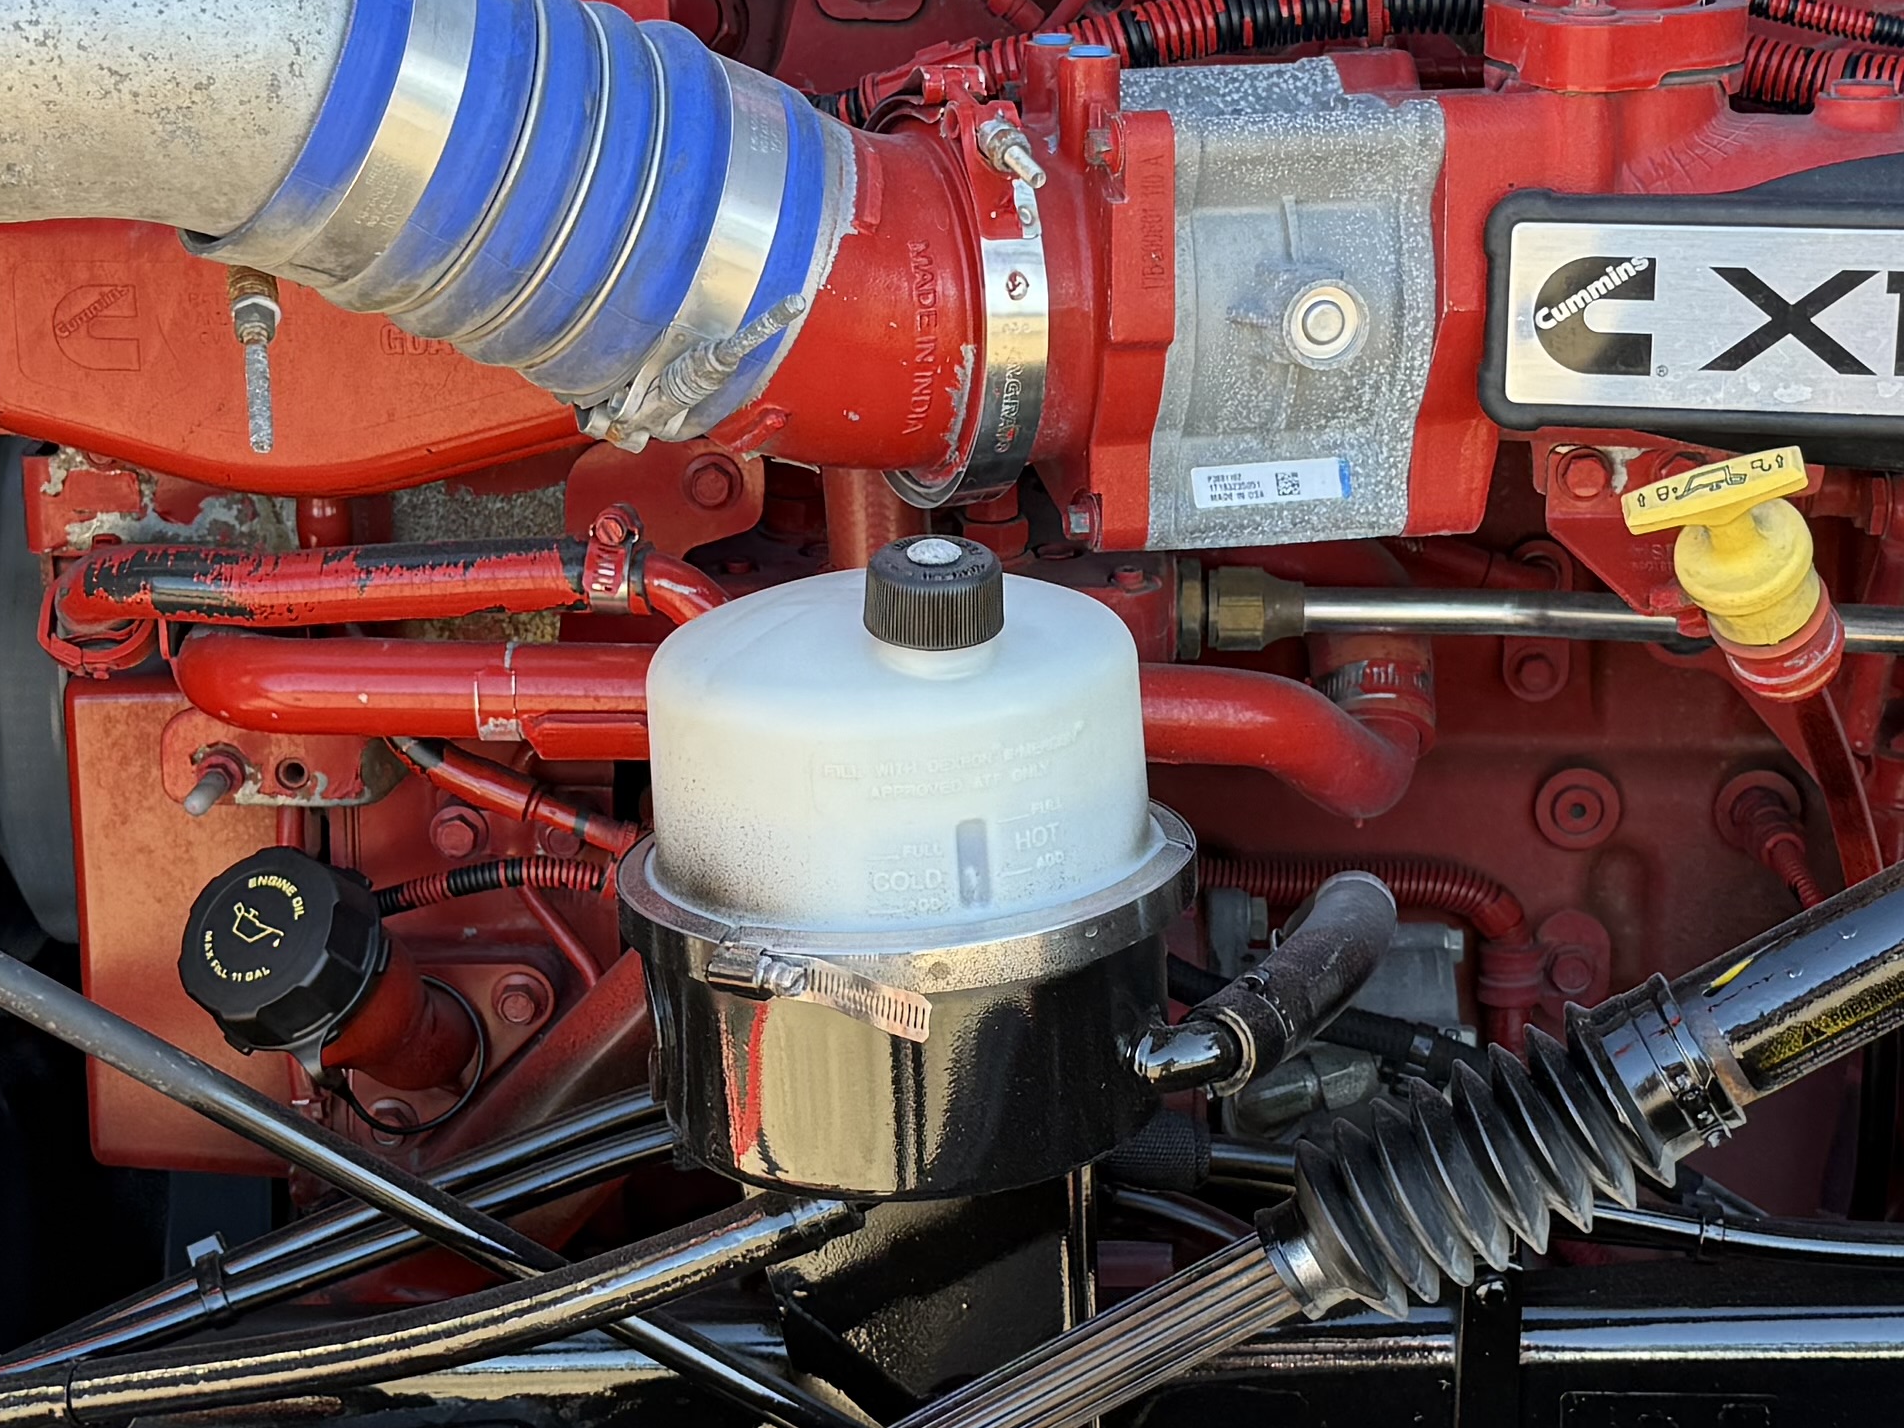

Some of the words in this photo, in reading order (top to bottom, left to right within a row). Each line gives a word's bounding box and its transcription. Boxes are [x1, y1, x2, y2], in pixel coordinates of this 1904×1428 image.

[907, 239, 939, 332] MADE
[1534, 255, 1651, 332] Cummins
[53, 283, 130, 340] Cummins
[914, 336, 936, 364] IN
[901, 368, 941, 436] INDIA
[823, 762, 864, 780] FILL
[902, 843, 944, 859] FULL
[1014, 821, 1060, 852] HOT
[248, 875, 298, 897] ENGINE
[292, 896, 305, 921] OIL
[871, 868, 944, 893] COLD
[204, 930, 214, 960] MAX
[245, 966, 271, 982] GAL
